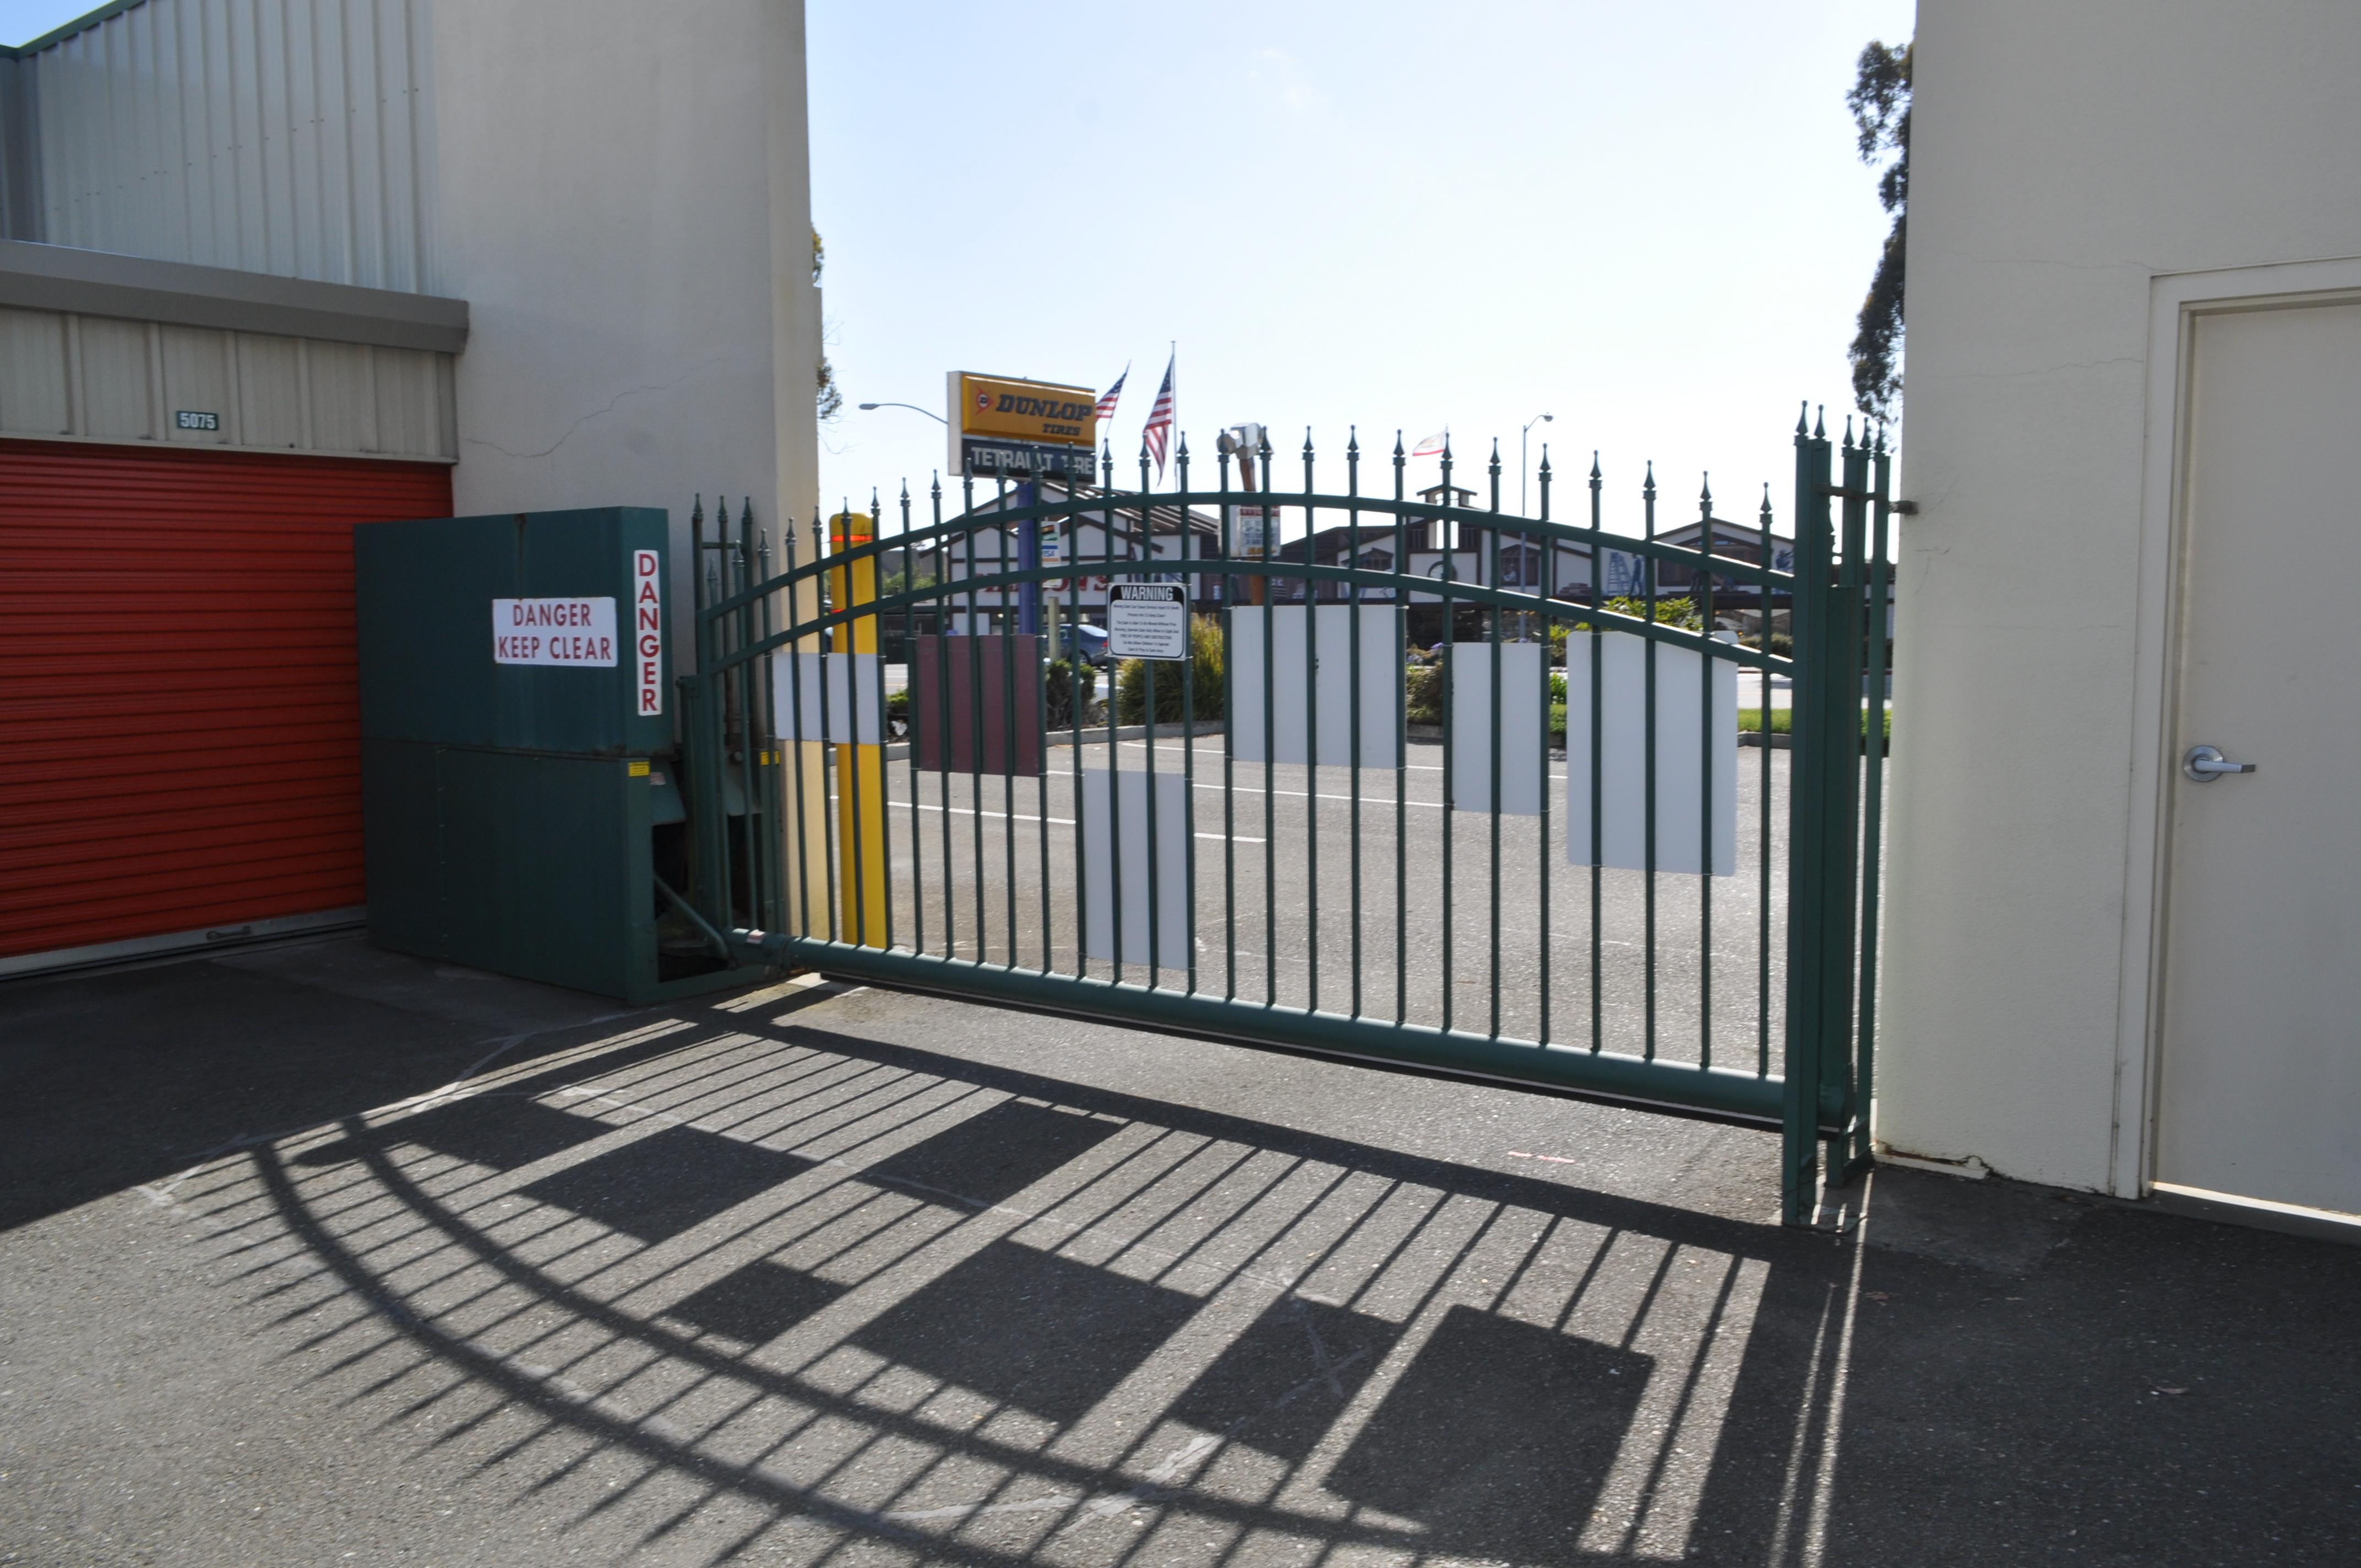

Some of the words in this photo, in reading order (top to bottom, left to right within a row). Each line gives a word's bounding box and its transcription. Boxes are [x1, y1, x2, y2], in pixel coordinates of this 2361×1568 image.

[996, 394, 1092, 421] DUNLOP
[179, 412, 216, 429] 5075
[1043, 424, 1080, 435] TIRES
[1060, 455, 1094, 475] TRE
[1120, 586, 1173, 601] WARNING
[513, 604, 591, 626] DANGER
[639, 554, 660, 711] DANGER
[498, 636, 540, 658] KEEP
[550, 636, 612, 660] CLEAR
